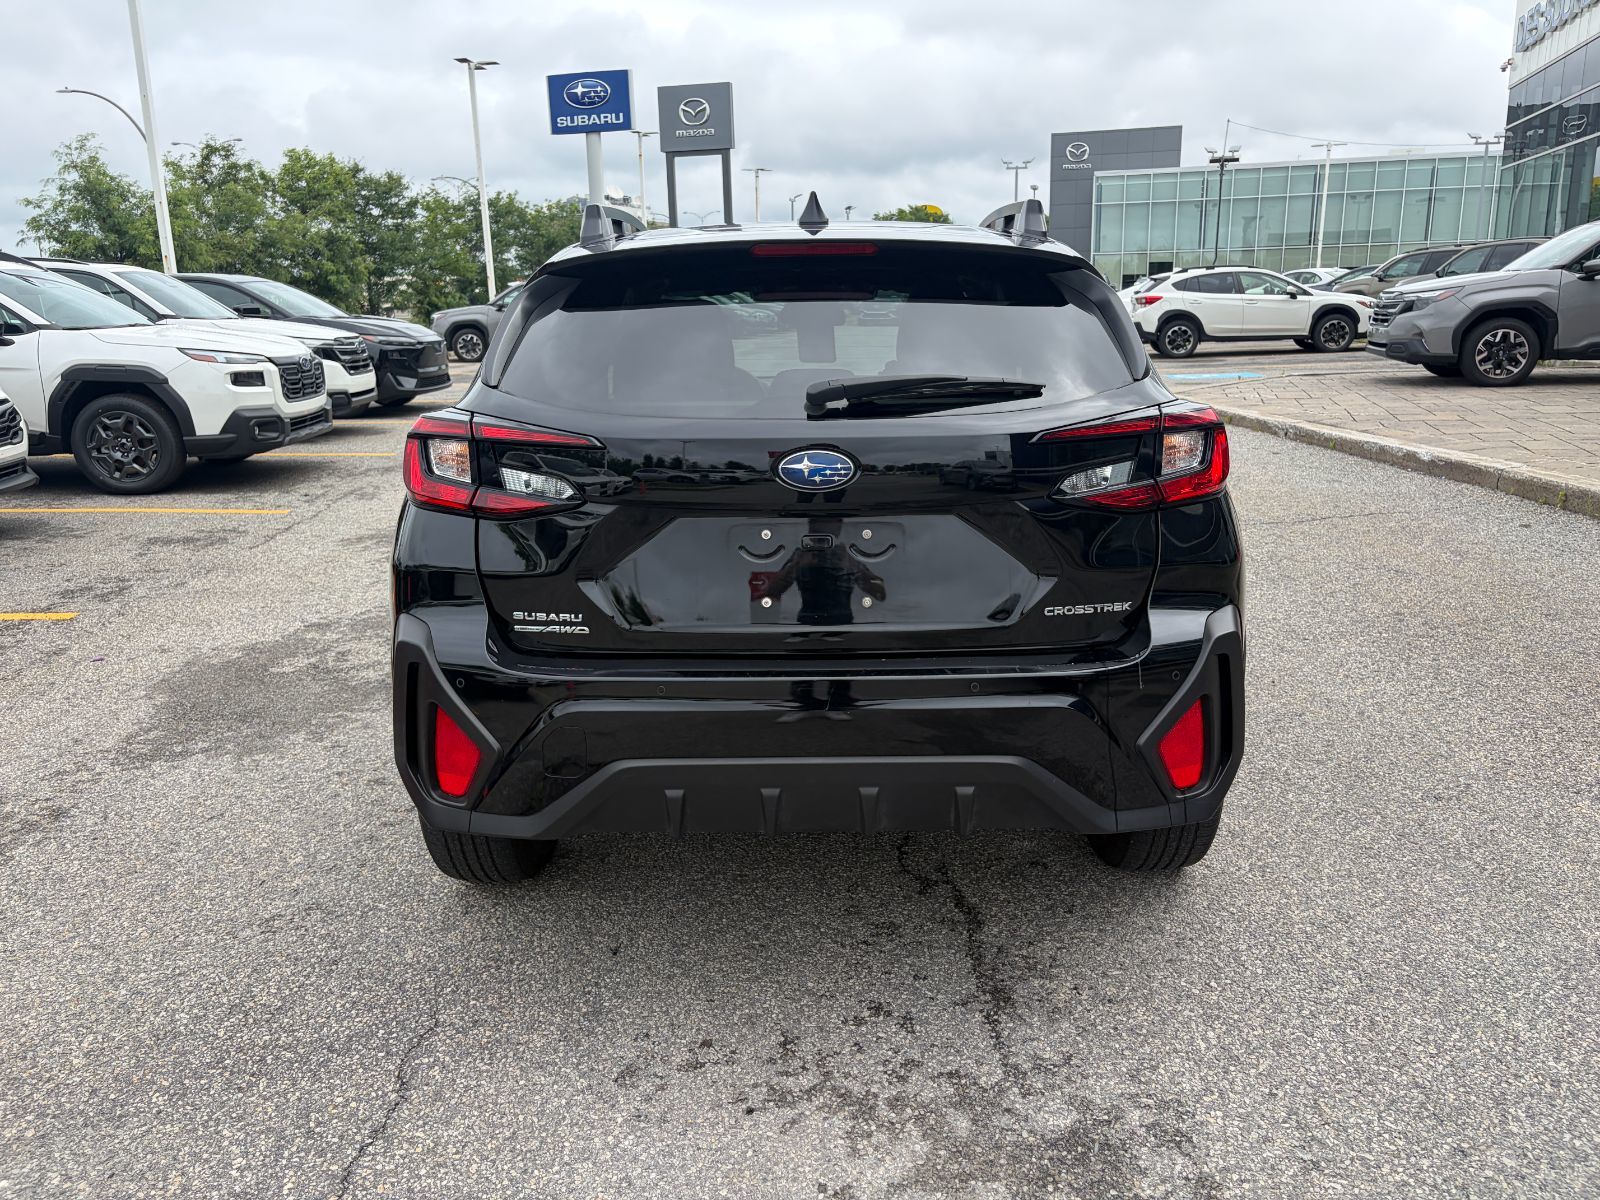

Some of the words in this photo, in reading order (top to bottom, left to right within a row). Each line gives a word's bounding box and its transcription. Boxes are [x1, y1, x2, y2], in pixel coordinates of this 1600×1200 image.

[557, 112, 624, 128] SUBARU
[675, 128, 715, 137] mazda
[1044, 601, 1133, 616] CROSSTREK
[512, 611, 583, 622] SUBARU
[542, 625, 590, 634] AWD
